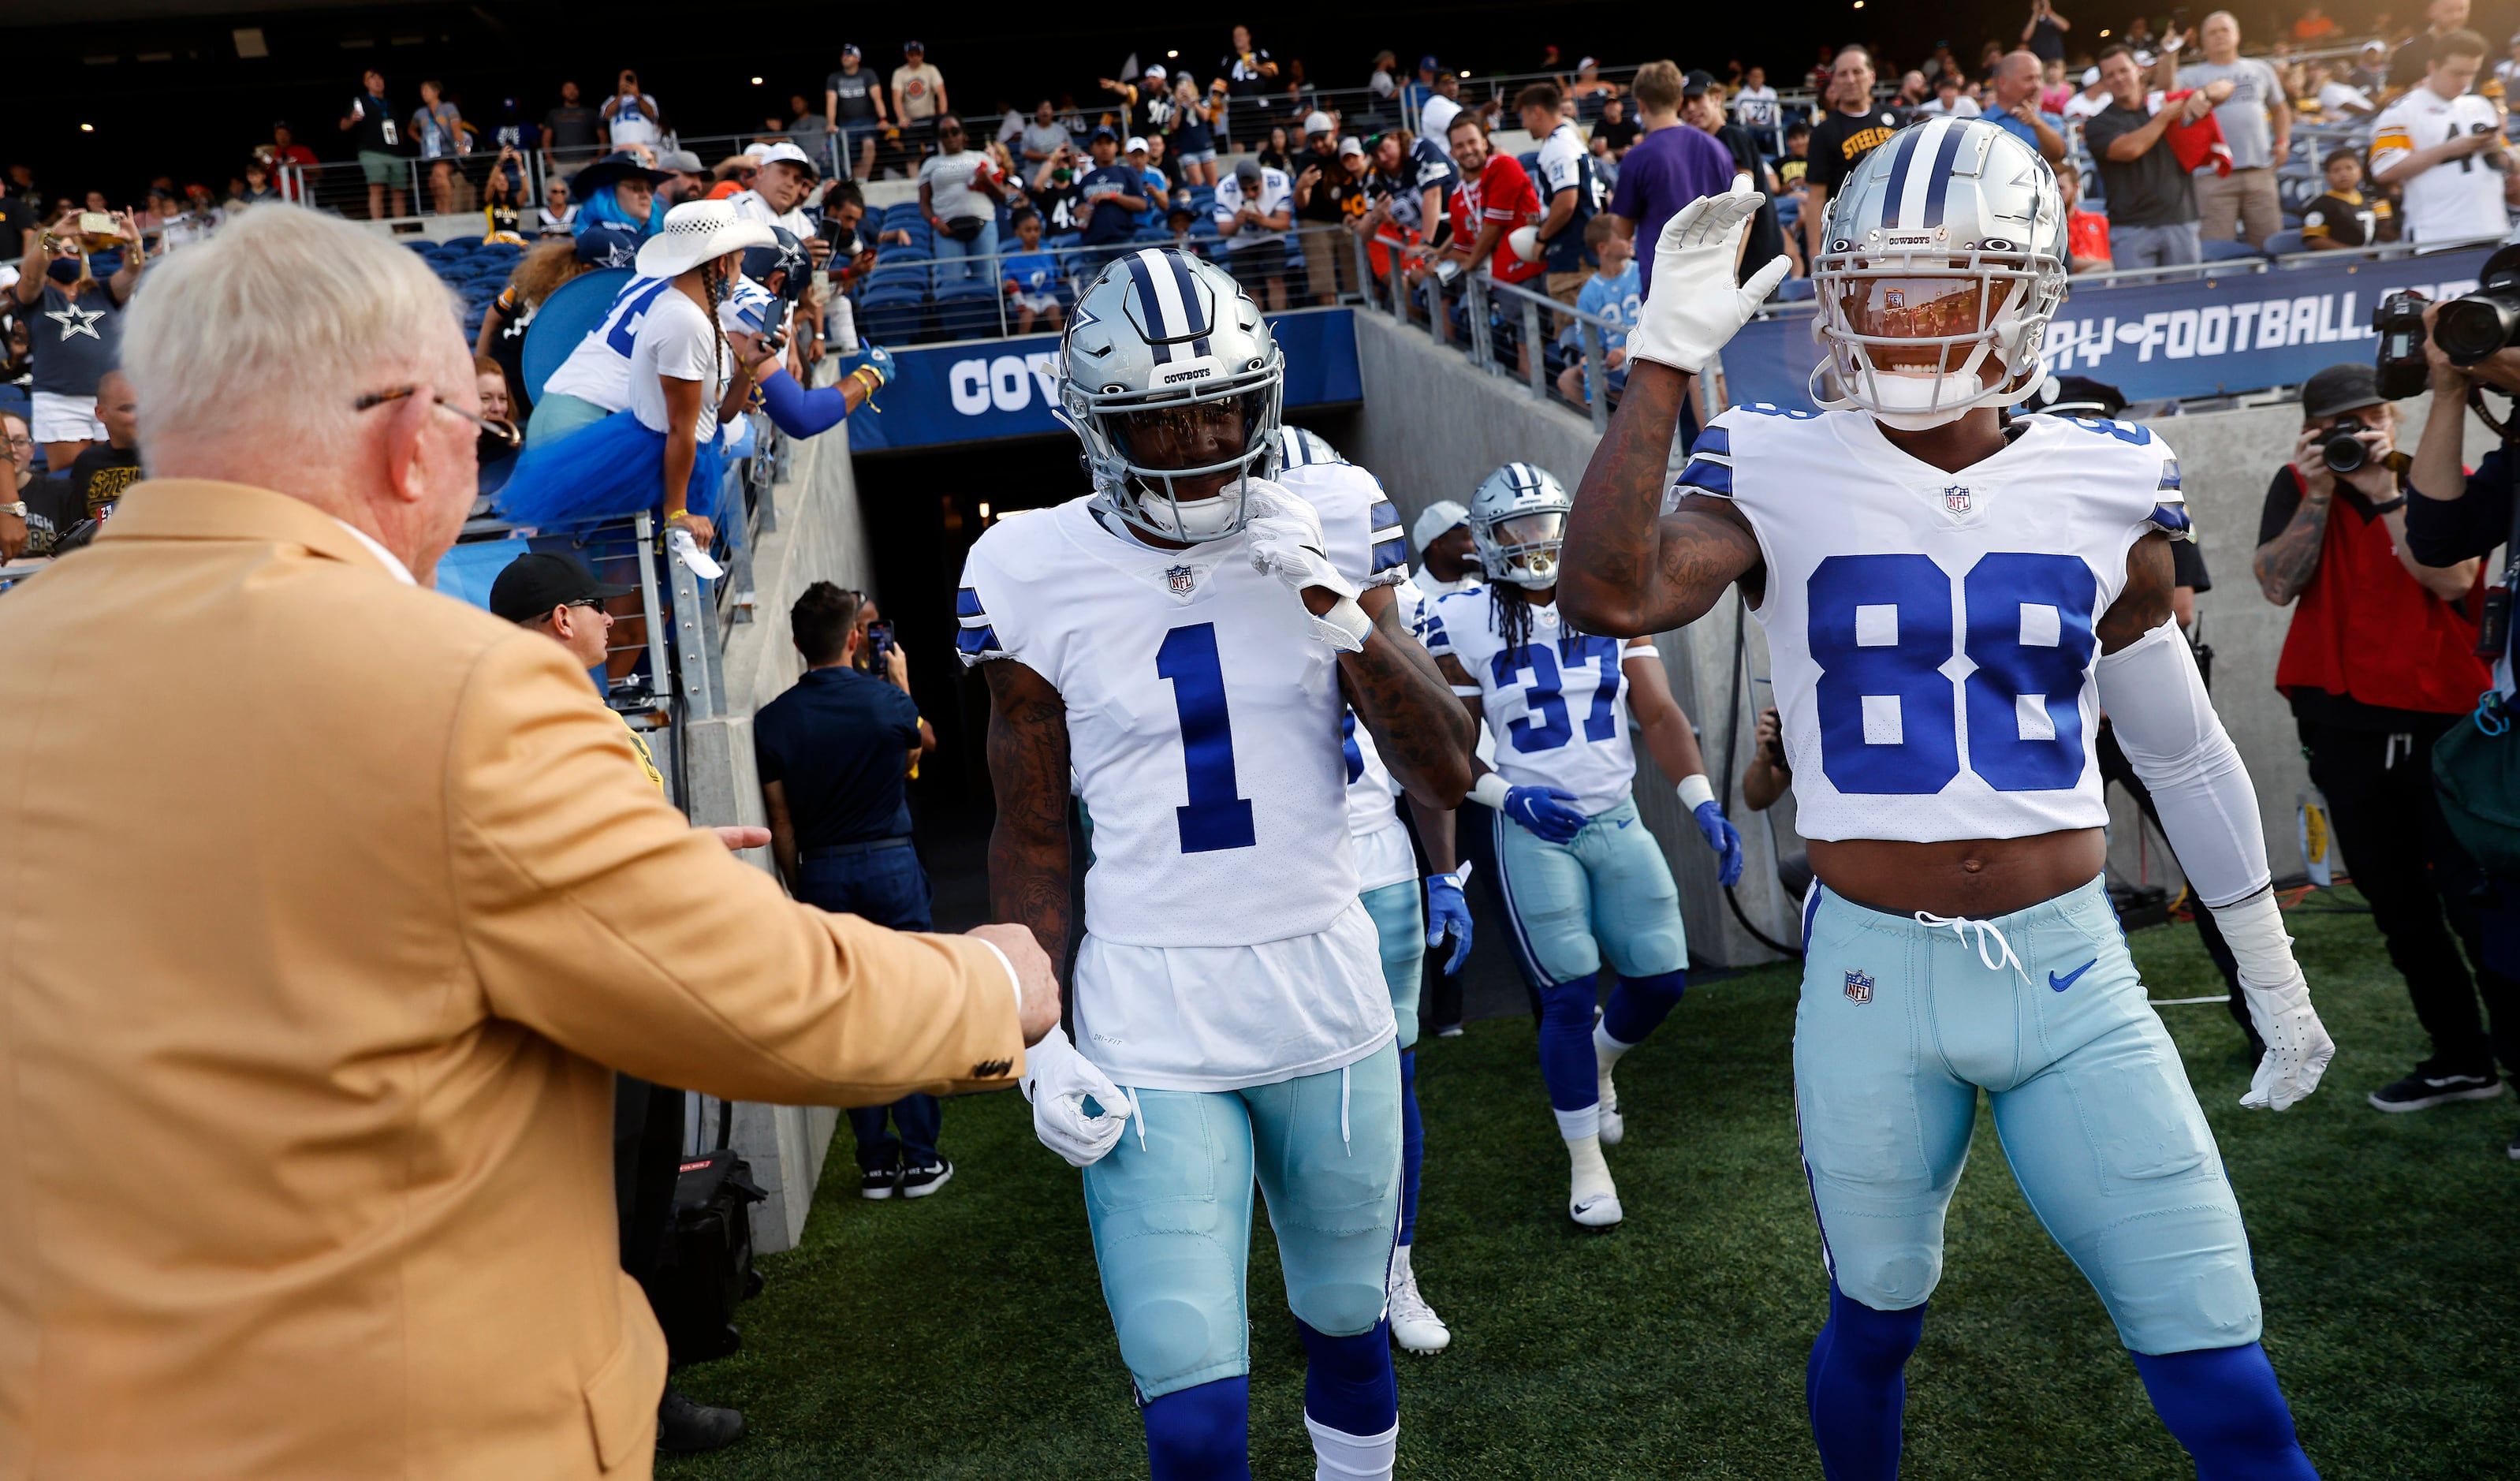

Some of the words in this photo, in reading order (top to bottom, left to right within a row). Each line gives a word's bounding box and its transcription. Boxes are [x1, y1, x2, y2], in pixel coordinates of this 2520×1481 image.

[1888, 237, 1930, 245] COWBOYS
[1164, 367, 1210, 384] COWBOYS
[1948, 497, 1969, 509] NFL
[1172, 576, 1191, 589] NFL
[1806, 551, 2097, 795] 88
[1490, 635, 1621, 754] 37
[1155, 621, 1257, 854] 1
[1848, 983, 1868, 999] NFL
[1094, 1034, 1123, 1046] DRI-FIT
